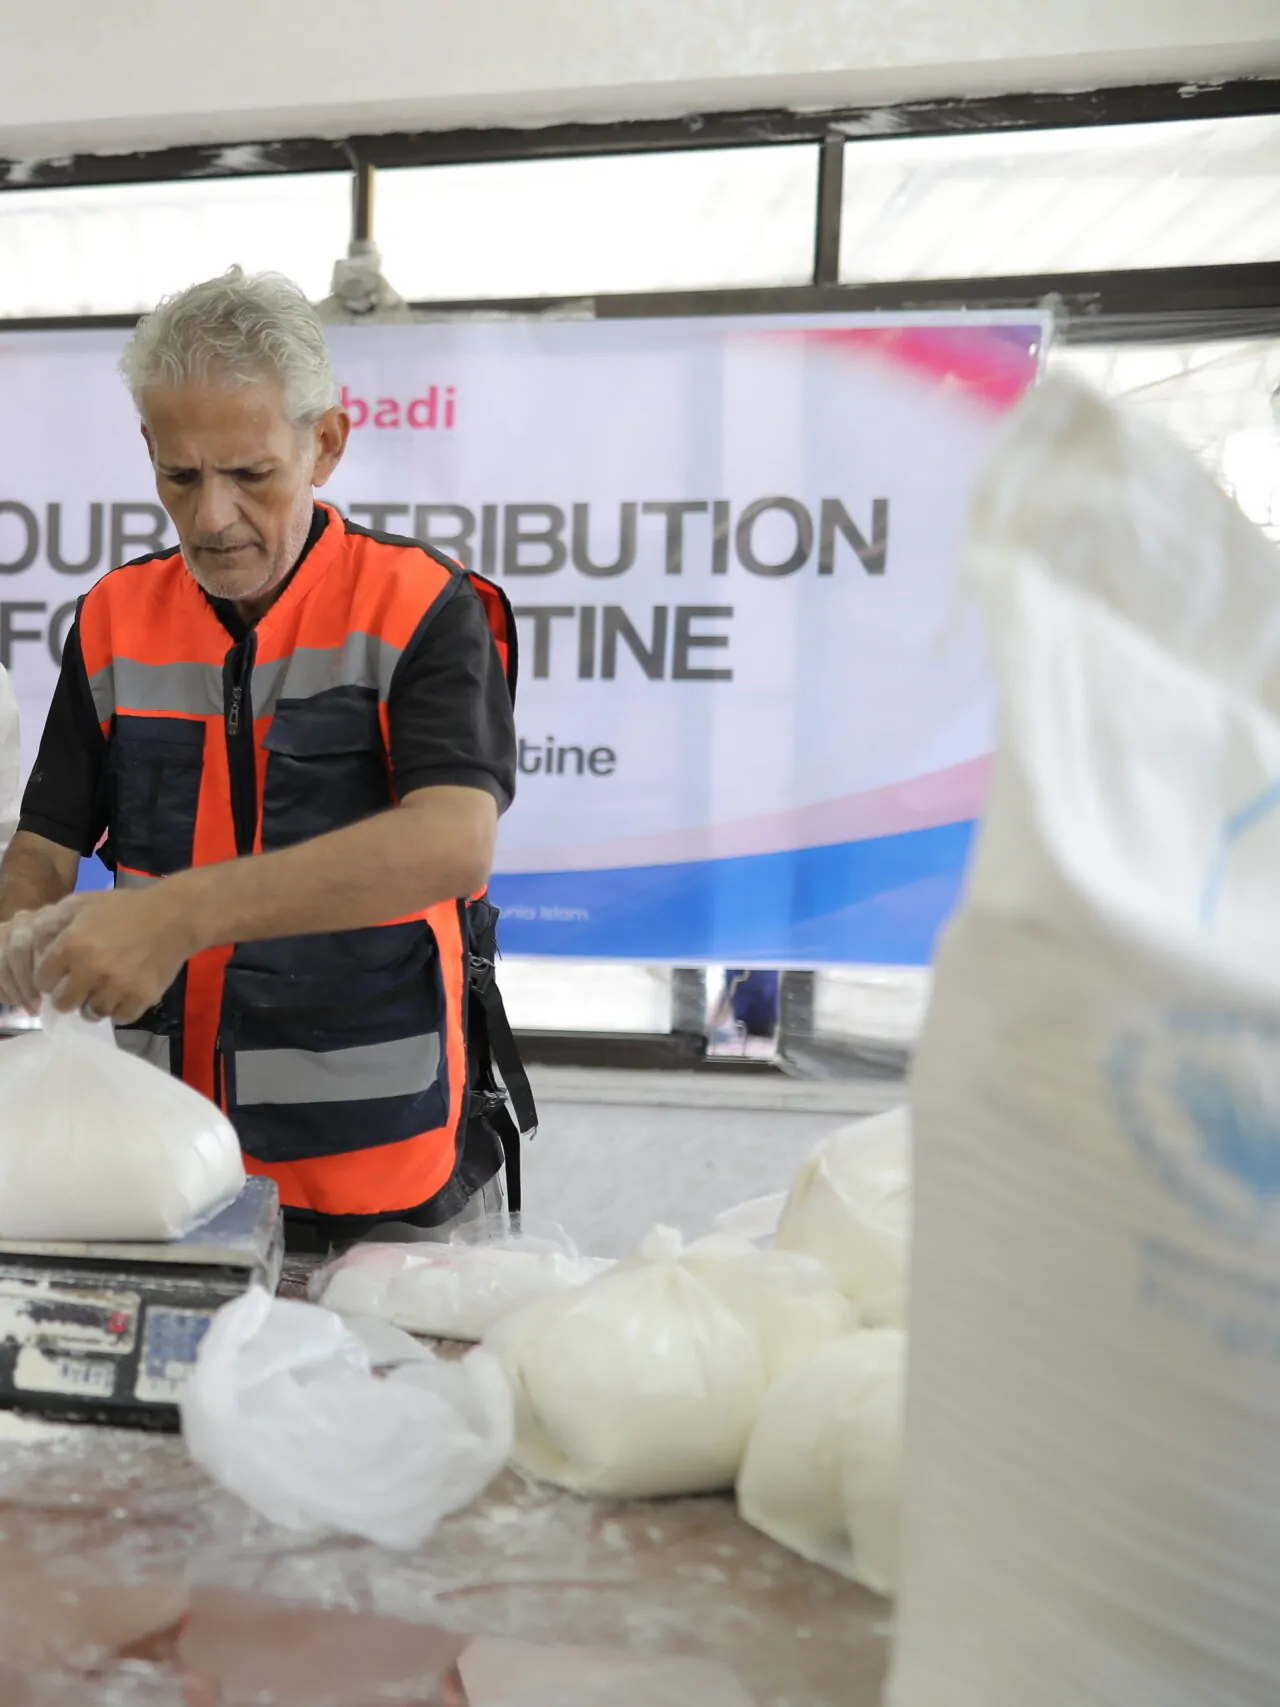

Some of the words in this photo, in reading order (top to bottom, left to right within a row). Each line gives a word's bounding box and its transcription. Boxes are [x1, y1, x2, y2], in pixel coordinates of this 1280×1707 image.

[337, 385, 456, 430] badi
[321, 496, 889, 579] TRIBUTION
[514, 604, 734, 682] TINE
[517, 736, 617, 776] tine
